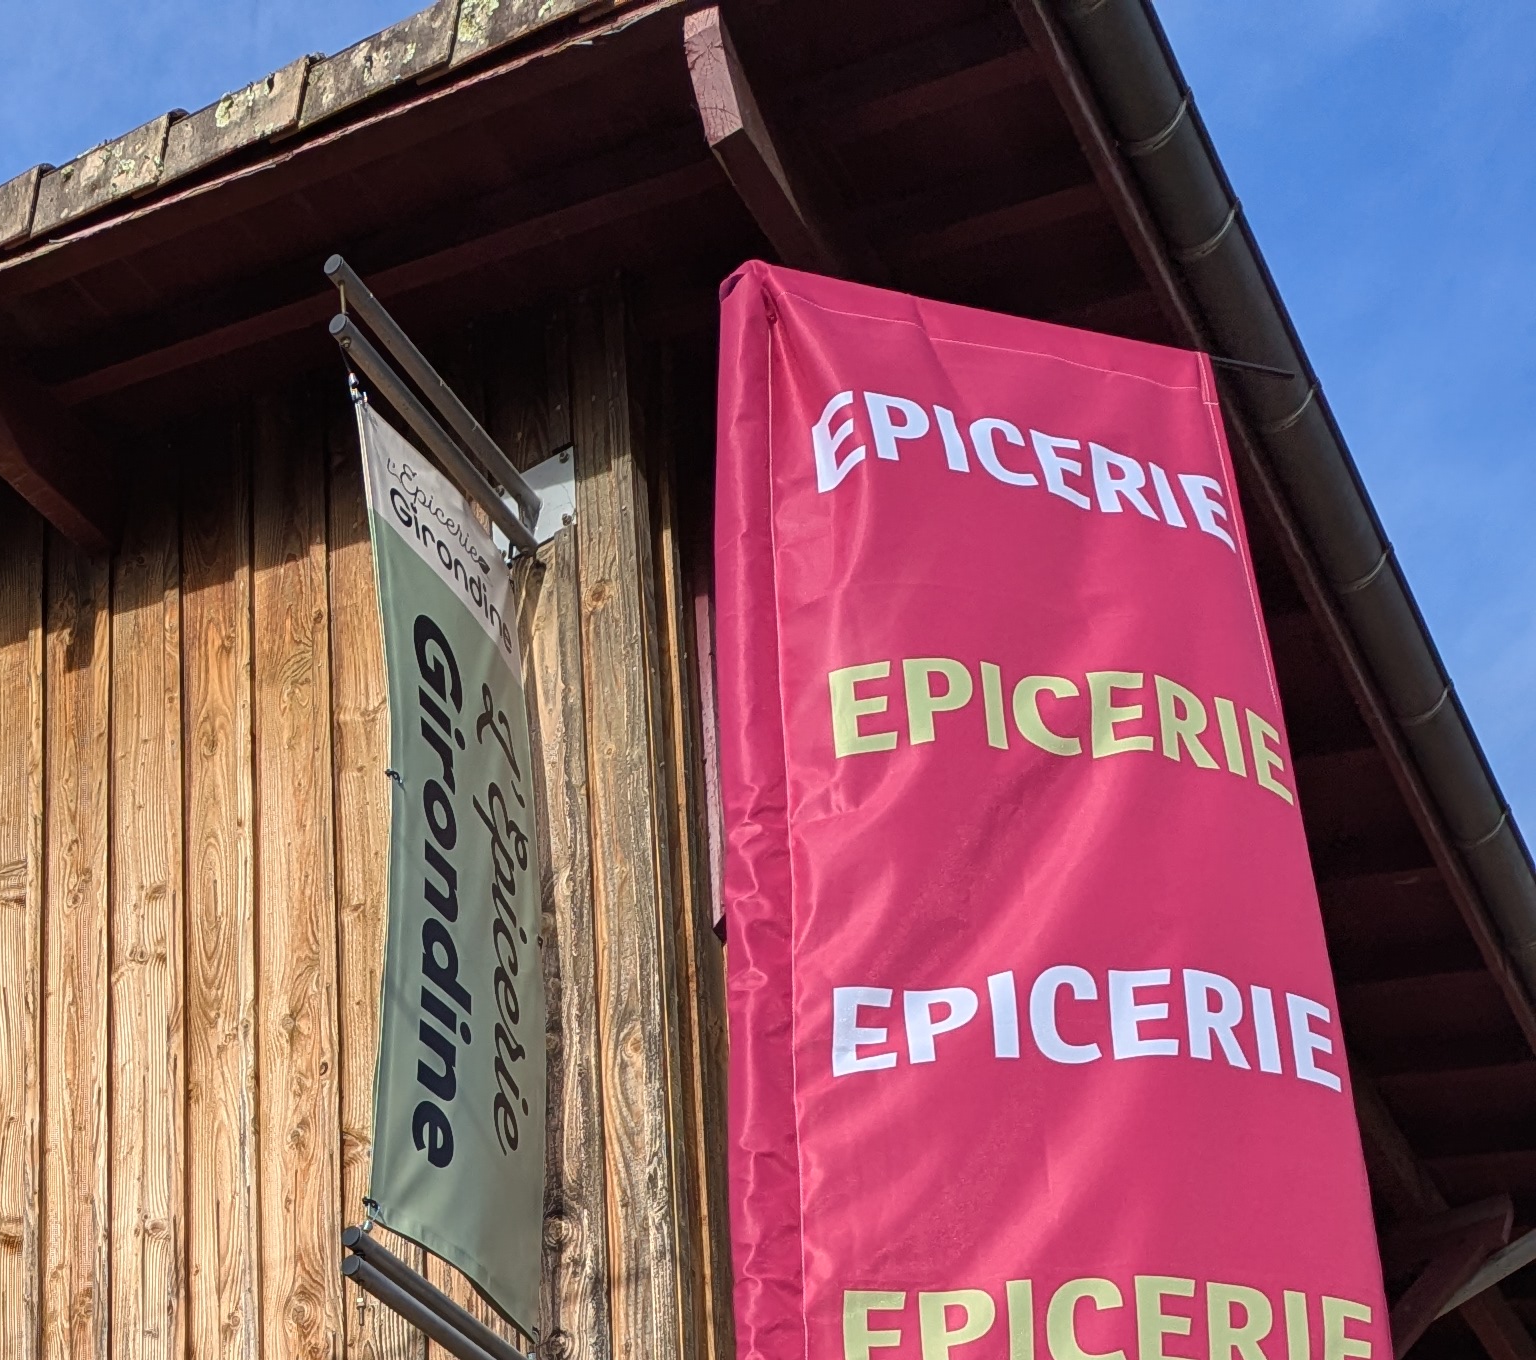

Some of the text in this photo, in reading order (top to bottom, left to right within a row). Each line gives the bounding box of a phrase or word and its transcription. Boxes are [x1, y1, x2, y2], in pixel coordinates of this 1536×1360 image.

[812, 390, 1236, 552] EPICERIE
[389, 487, 513, 655] Girondine
[827, 657, 1294, 806] EPICERIE
[412, 613, 472, 1169] Girondine
[831, 965, 1342, 1093] EPICERIE
